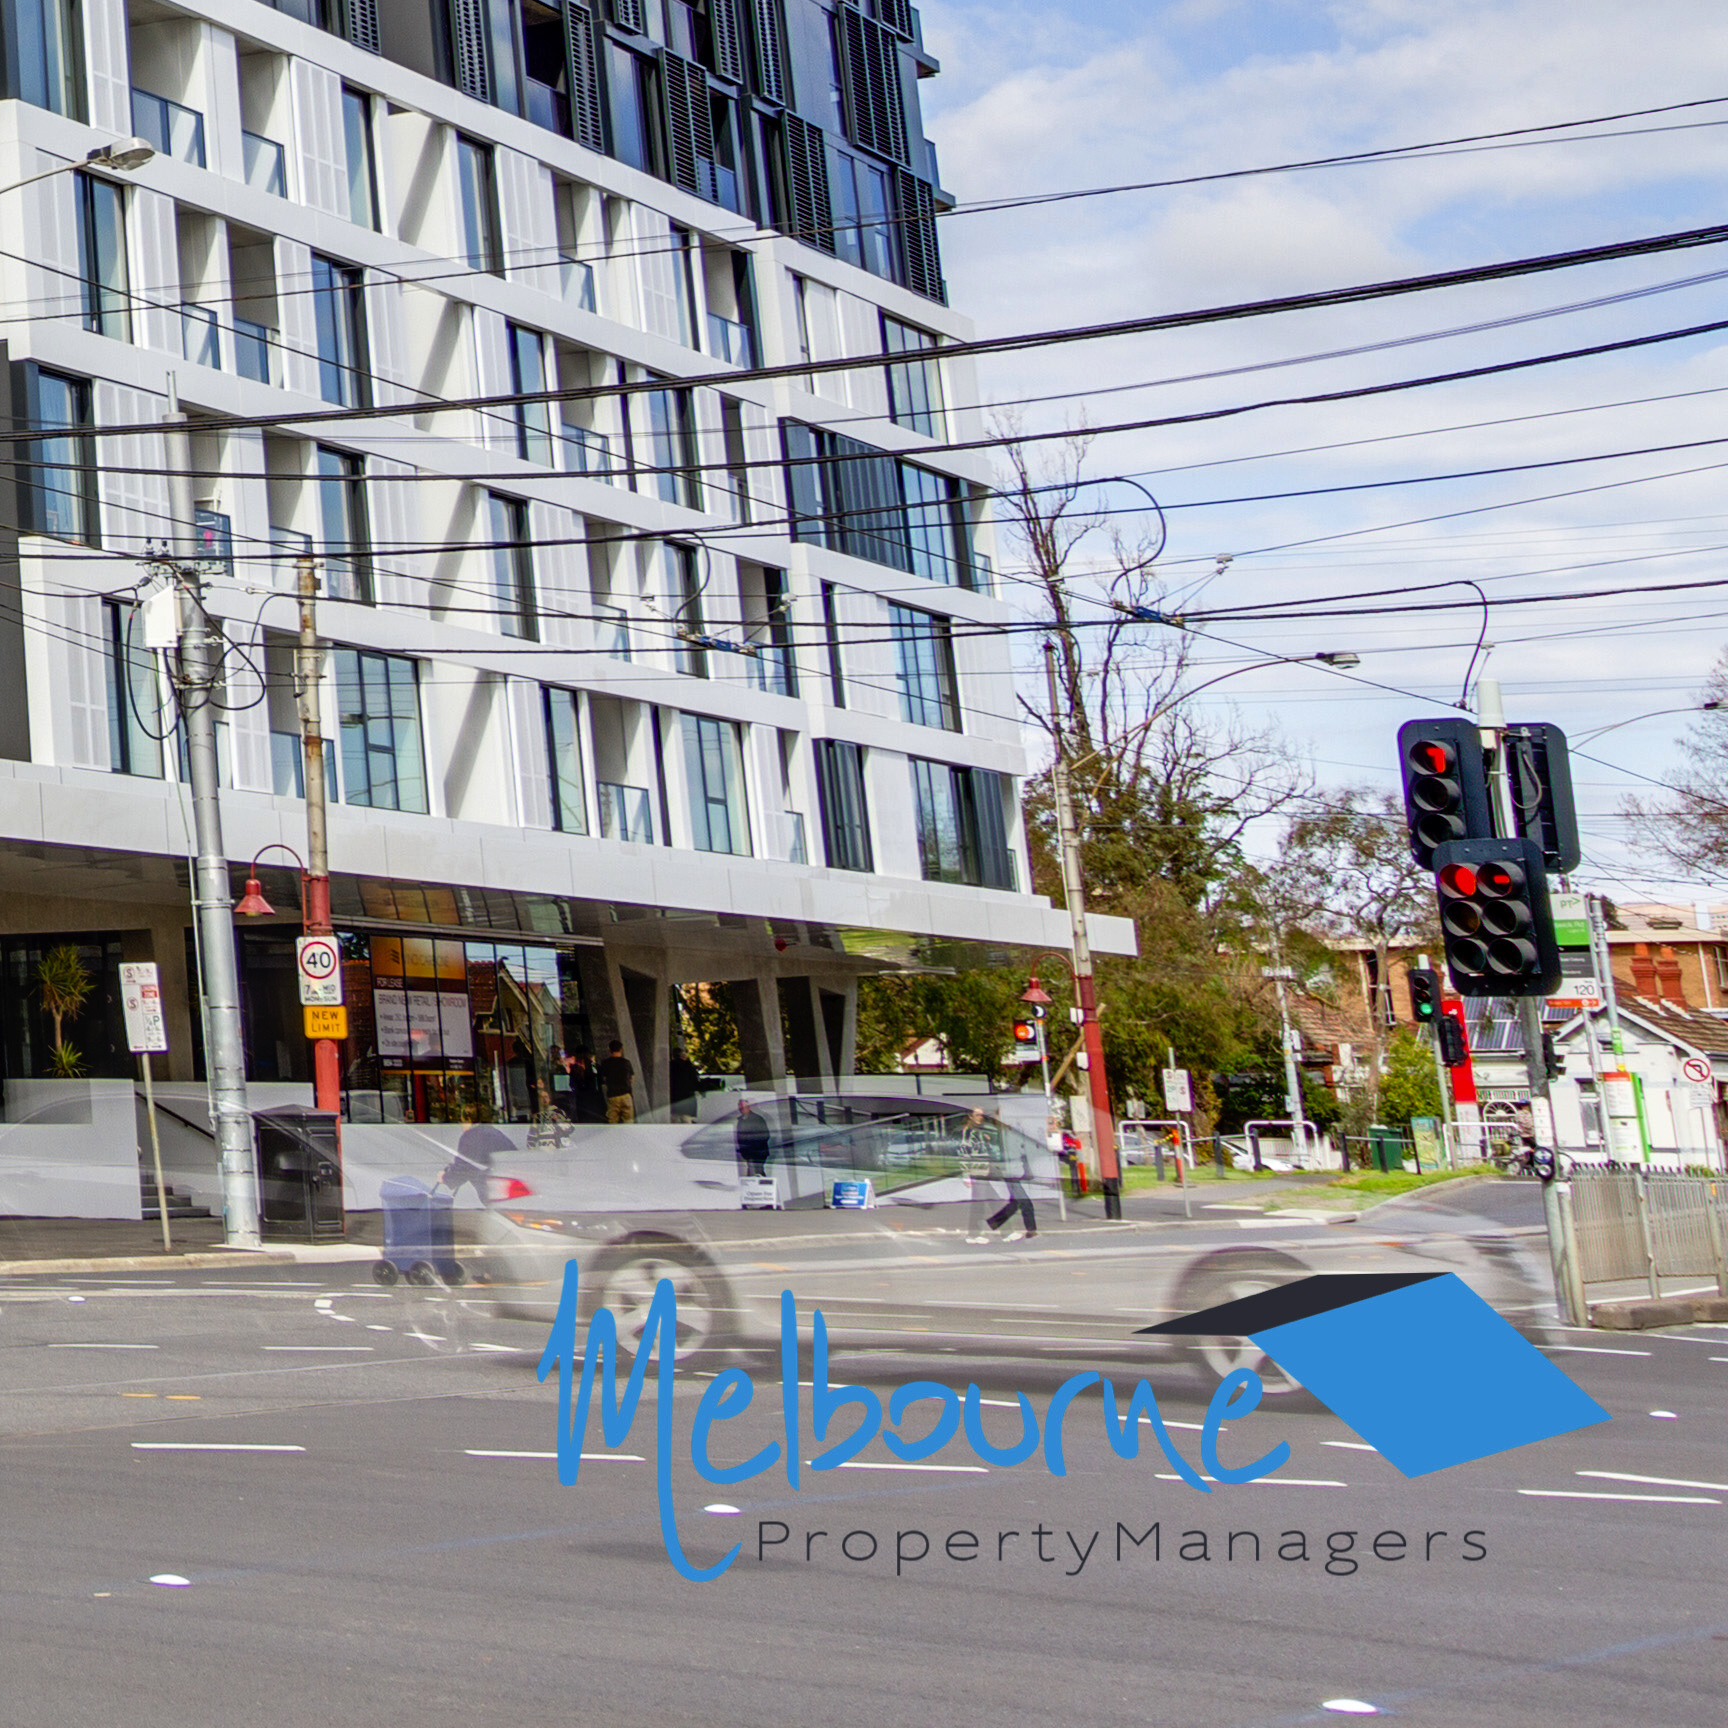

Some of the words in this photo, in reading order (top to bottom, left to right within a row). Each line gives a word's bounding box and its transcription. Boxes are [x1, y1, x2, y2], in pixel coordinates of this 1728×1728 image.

[306, 951, 331, 969] 40
[1574, 984, 1595, 996] 120
[312, 1010, 338, 1021] NEW
[311, 1023, 341, 1033] LIMIT
